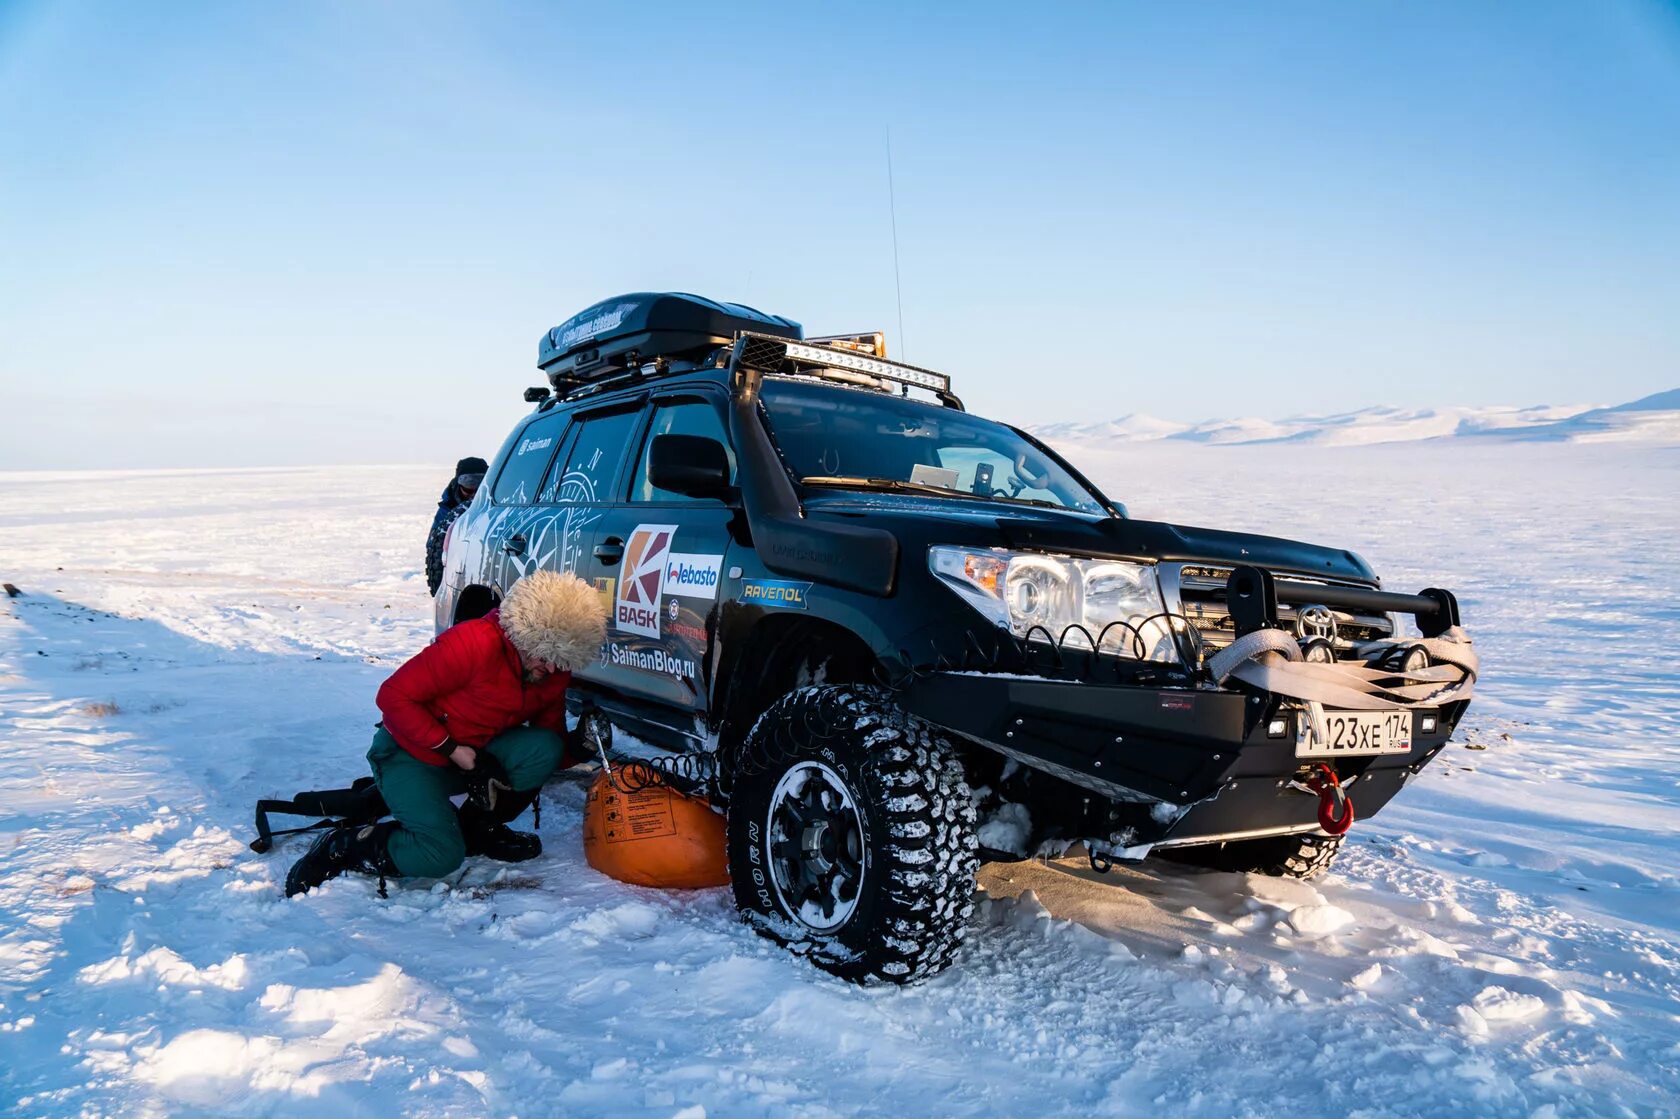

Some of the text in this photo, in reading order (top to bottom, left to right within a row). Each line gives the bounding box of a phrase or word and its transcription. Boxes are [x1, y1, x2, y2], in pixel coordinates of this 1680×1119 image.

[668, 562, 717, 586] Webasto
[744, 585, 802, 602] RAVENOL
[619, 605, 657, 629] BASK
[611, 643, 695, 681] SaimanBlog.ru
[1385, 715, 1409, 738] 174
